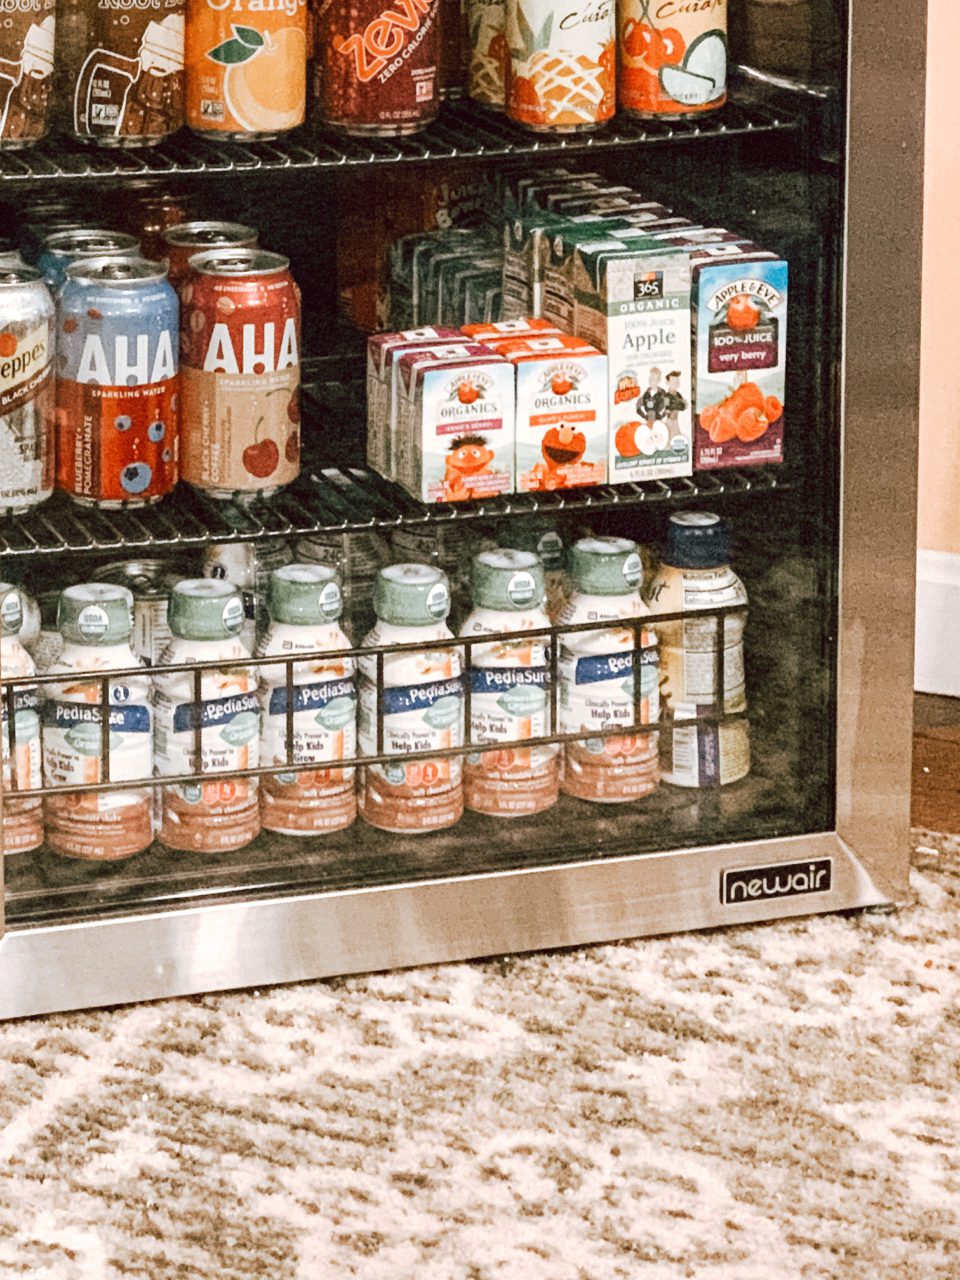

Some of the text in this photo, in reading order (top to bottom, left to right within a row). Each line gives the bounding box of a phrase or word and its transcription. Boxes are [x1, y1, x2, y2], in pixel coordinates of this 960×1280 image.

[377, 57, 404, 84] ZERO
[637, 282, 660, 297] 365
[714, 281, 745, 310] APPLE
[757, 283, 778, 305] EVE
[619, 298, 680, 314] ORGANIC
[203, 317, 299, 375] AHA
[622, 328, 676, 352] Apple
[713, 332, 773, 347] 100% JUICE
[76, 329, 177, 388] AHA
[719, 351, 767, 363] very berry
[1, 385, 30, 407] BLACK
[91, 386, 166, 399] SPARKLING WATER
[534, 393, 591, 409] ORGANICS
[440, 402, 498, 418] ORGANICS
[83, 415, 93, 495] POMEGRANATE
[210, 442, 219, 482] COFFEE
[83, 614, 103, 623] USDA
[485, 670, 552, 688] PediaSure
[56, 705, 126, 728] PediaSre
[591, 709, 630, 721] Help Kids
[489, 723, 508, 734] Kids
[306, 739, 325, 751] Kids
[391, 739, 432, 754] Help Kids
[212, 756, 230, 768] Kids
[292, 751, 316, 763] Grow
[730, 864, 827, 900] newair
